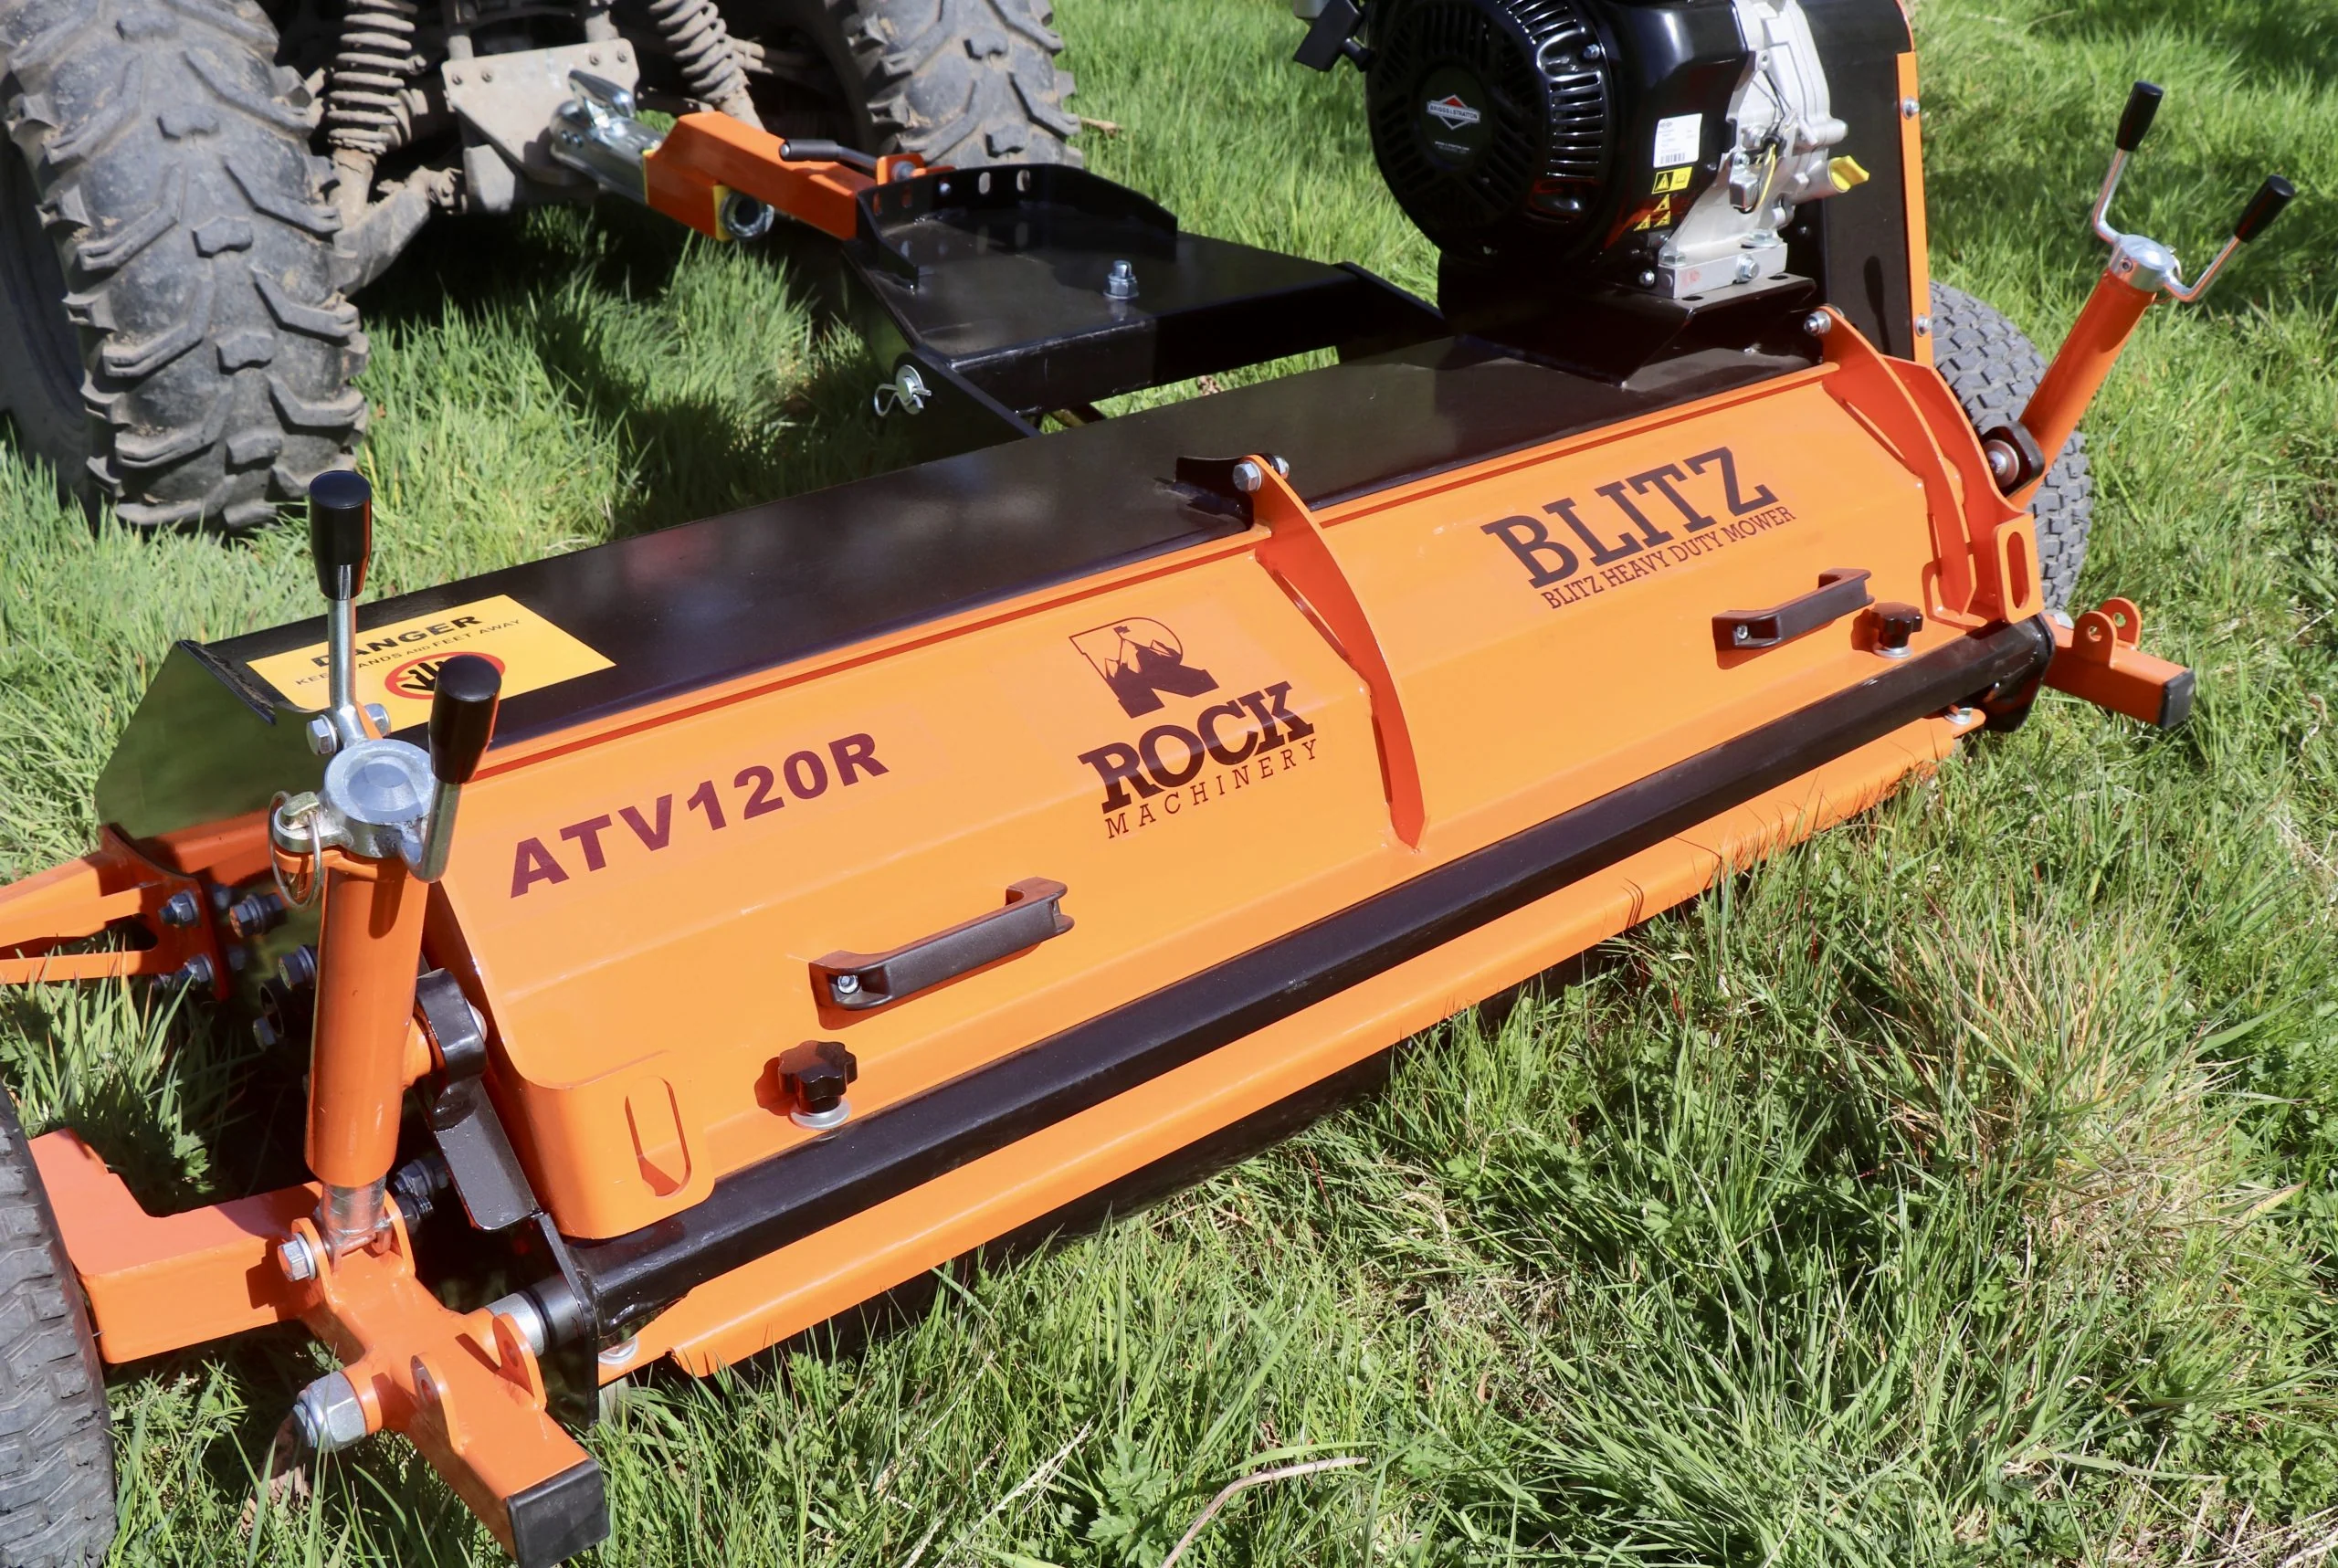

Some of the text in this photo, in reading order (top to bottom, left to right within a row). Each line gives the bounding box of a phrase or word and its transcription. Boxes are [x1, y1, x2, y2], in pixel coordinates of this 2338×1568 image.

[1480, 446, 1780, 589] BLITZ
[1541, 506, 1796, 609] BLITZ HEAVY DUTY MOWER
[295, 619, 520, 686] KEE ANDS AND FEET AWAY
[1077, 680, 1315, 815] ROCK
[1104, 738, 1318, 839] MACHINERY
[510, 732, 890, 899] ATV120R
